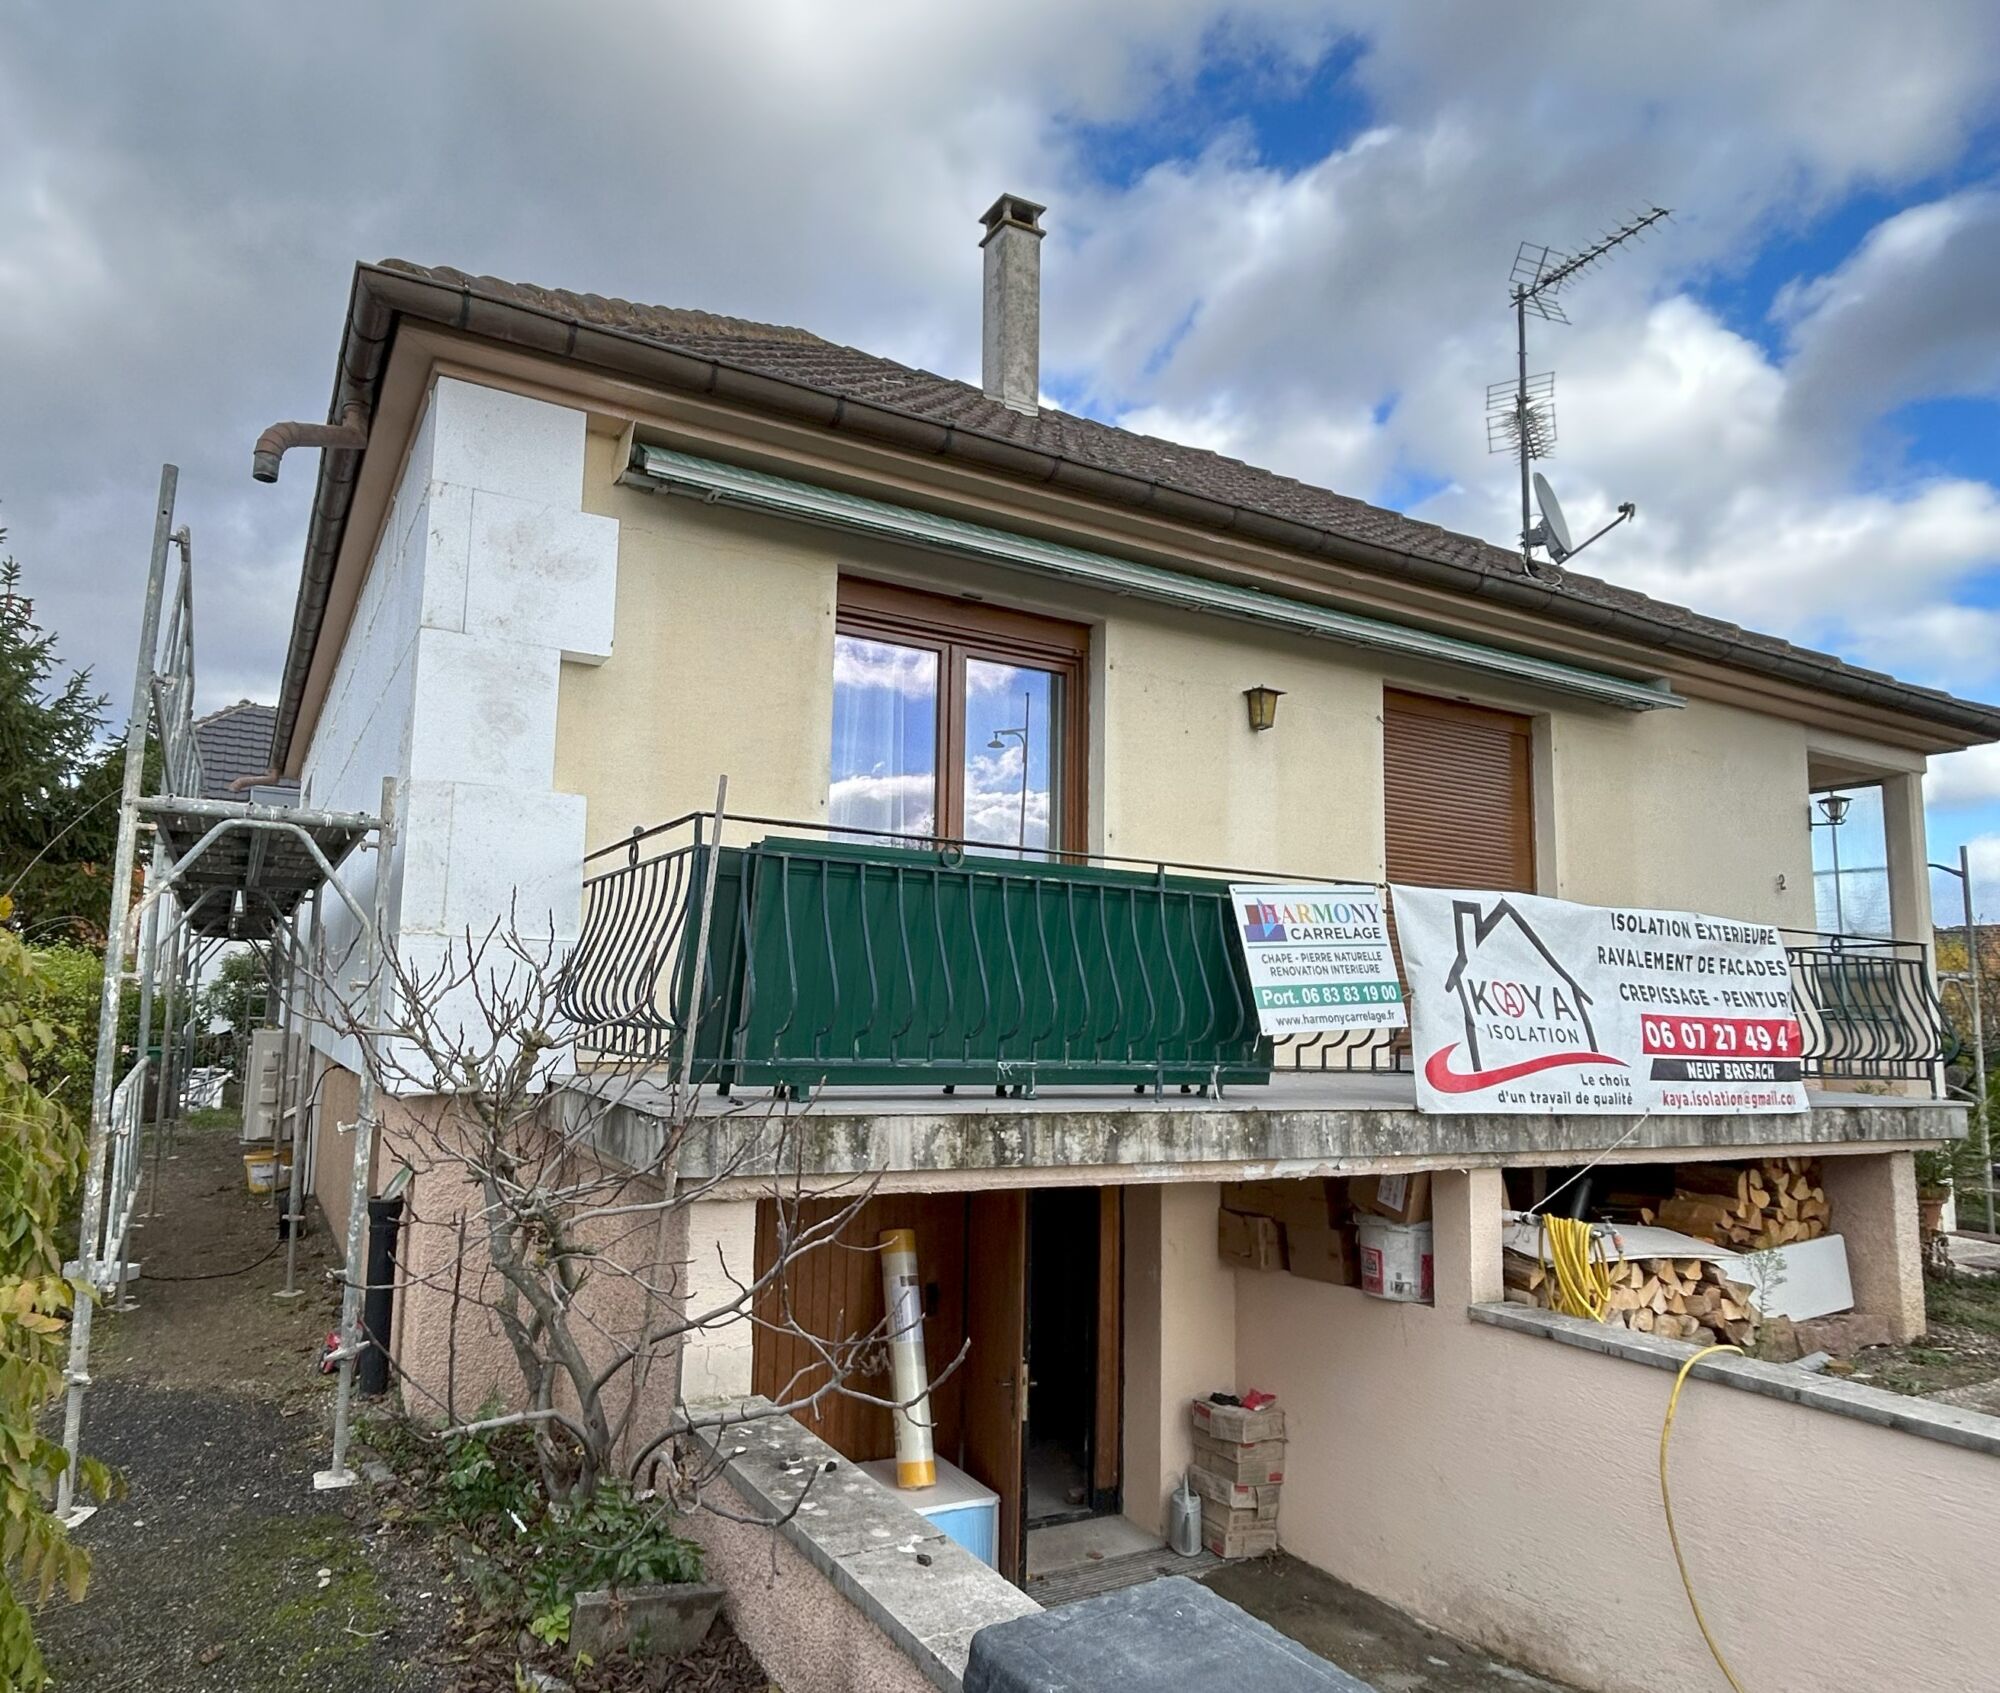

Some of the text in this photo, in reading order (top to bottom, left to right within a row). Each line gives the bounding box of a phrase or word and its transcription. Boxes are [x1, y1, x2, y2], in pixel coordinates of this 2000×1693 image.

[1263, 902, 1378, 925] HARMONY
[1290, 926, 1382, 941] CARRELAGE
[1611, 912, 1777, 945] ISOLATION EXTERIEURE
[1261, 953, 1293, 965] CHAPE
[1301, 952, 1333, 963] PIERRE
[1334, 951, 1383, 962] NATURELLE
[1597, 946, 1787, 976] RAVALEMENT DE FACADES
[1270, 964, 1381, 977] RENOVATION INTERIEURE
[1262, 984, 1397, 1006] Port. 06 83 83 19 00
[1619, 983, 1711, 1006] CREPISSAGE
[1722, 990, 1790, 1008] PEINTUR
[1276, 1009, 1395, 1026] www.harmonycarrelage.fr
[1486, 1024, 1580, 1044] ISOLATION
[1645, 1021, 1676, 1049] 06
[1680, 1023, 1705, 1050] 07
[1745, 1025, 1772, 1051] 49
[1581, 1073, 1632, 1087] Le choix
[1686, 1062, 1775, 1080] NEUF BRISACH
[1498, 1090, 1634, 1107] d'un travail de qualité
[1662, 1090, 1796, 1109] kaya.isolation@gmail.co
